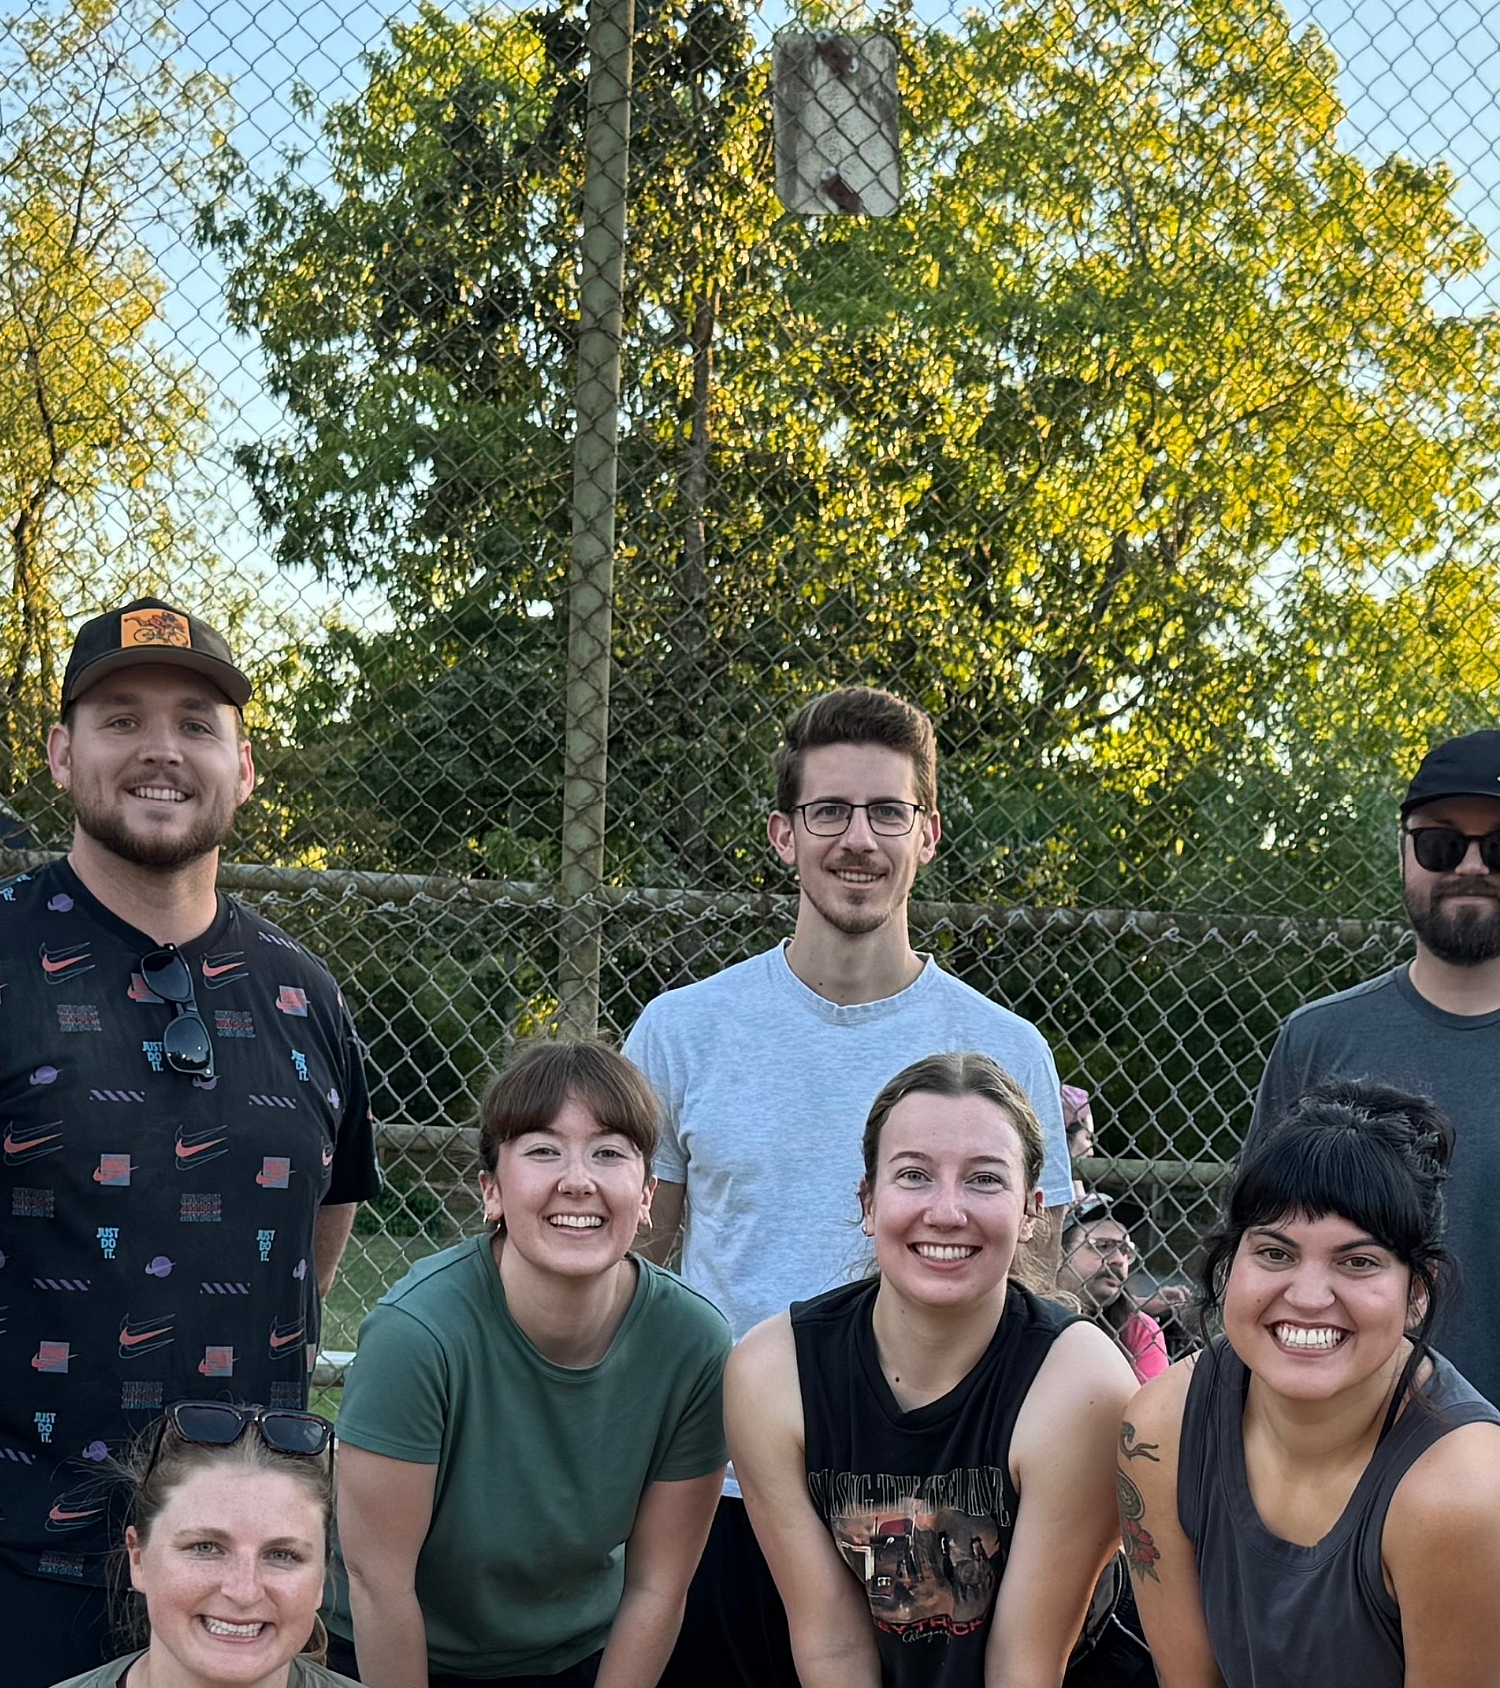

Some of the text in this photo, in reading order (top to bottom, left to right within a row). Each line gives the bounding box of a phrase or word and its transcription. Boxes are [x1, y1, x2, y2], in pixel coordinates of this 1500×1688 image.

[142, 1041, 163, 1051] JUST
[146, 1051, 162, 1061] DO
[96, 1227, 120, 1239] JUST
[256, 1229, 276, 1241] JUST
[100, 1237, 117, 1249] DO
[258, 1240, 272, 1251] DO
[34, 1411, 56, 1424] JUST
[37, 1422, 53, 1433] DO
